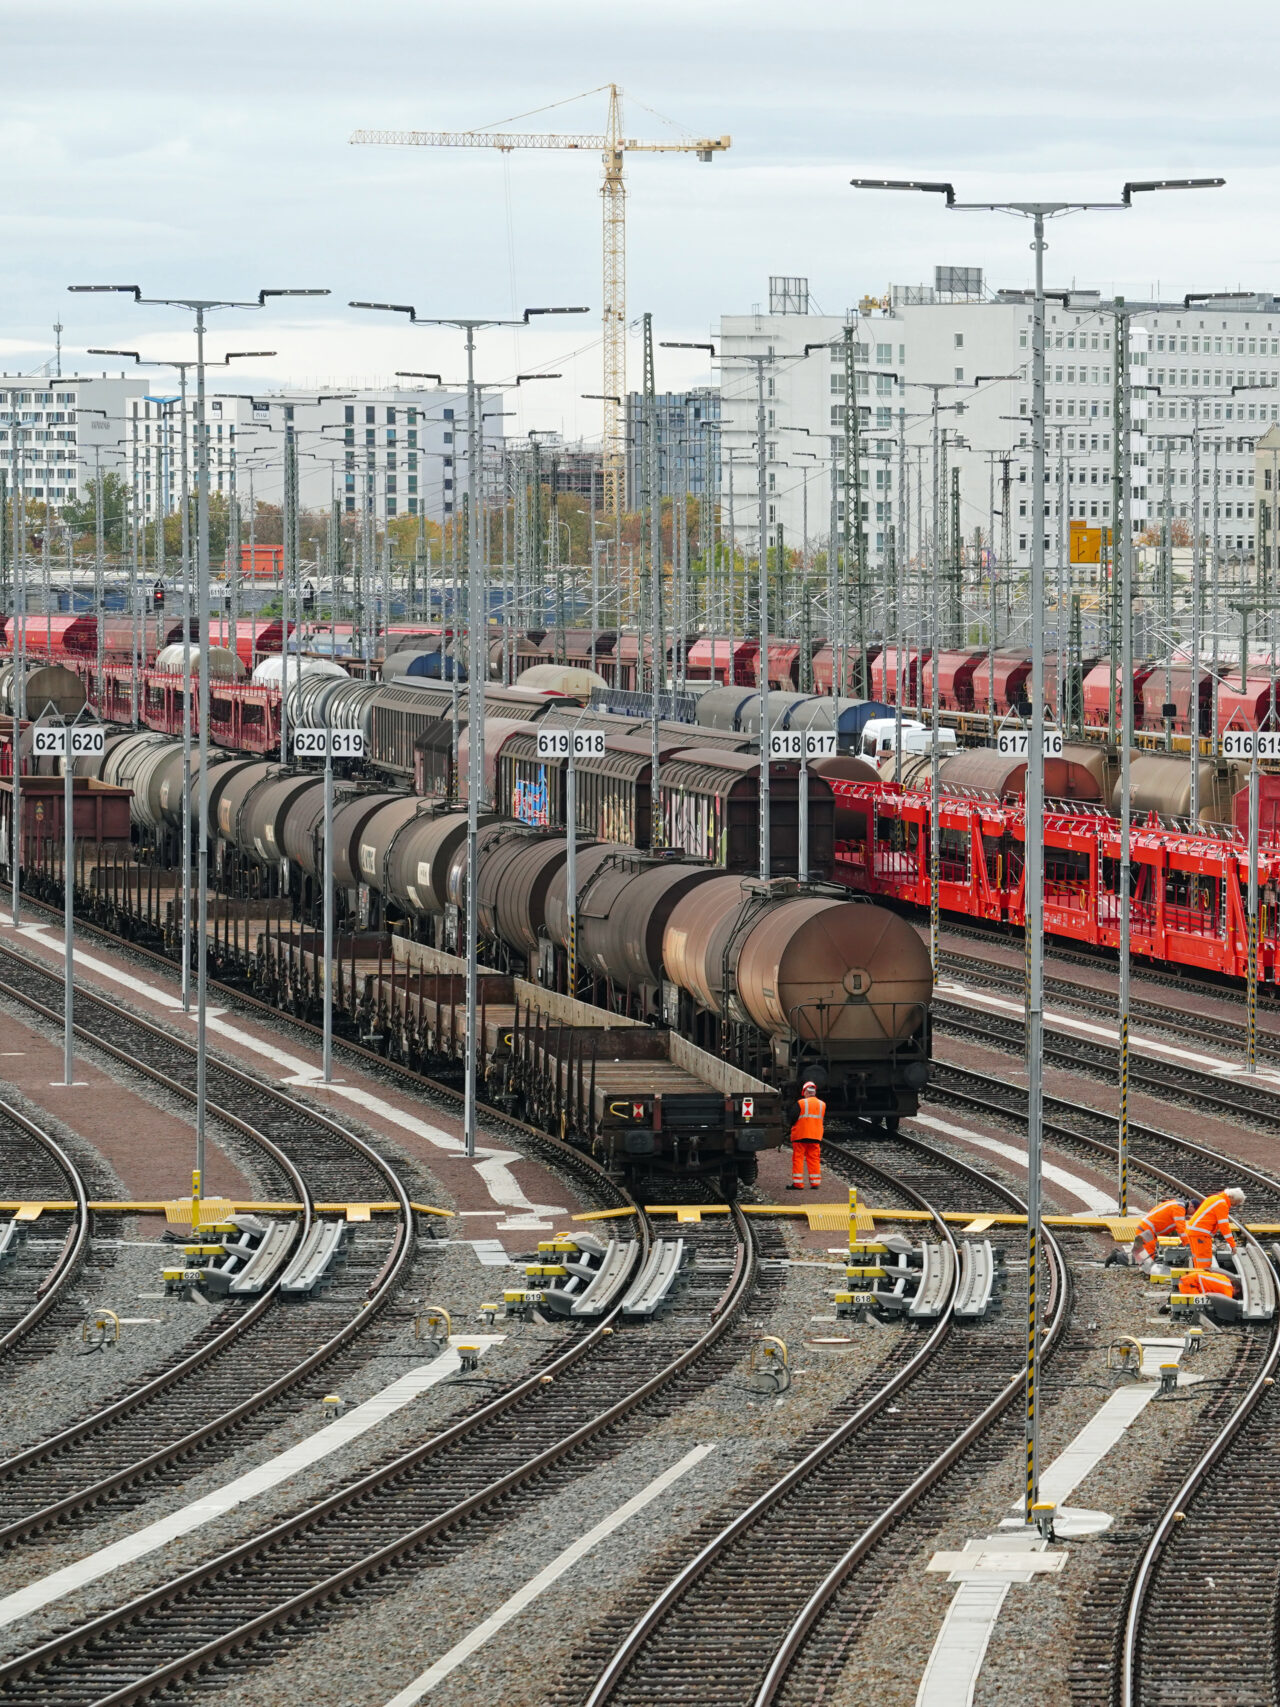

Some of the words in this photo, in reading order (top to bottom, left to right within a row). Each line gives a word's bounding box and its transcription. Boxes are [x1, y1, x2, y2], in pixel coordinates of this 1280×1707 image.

[35, 732, 65, 751] 621
[72, 733, 104, 751] 620
[295, 733, 326, 751] 620
[332, 734, 363, 752] 619
[538, 735, 568, 753] 619
[574, 735, 604, 753] 618
[771, 736, 801, 753] 618
[806, 736, 836, 753] 617
[999, 735, 1028, 753] 617
[1043, 736, 1062, 753] 16
[1224, 736, 1253, 754] 616
[184, 1271, 201, 1279] 620
[525, 1293, 542, 1301] 619
[855, 1295, 872, 1303] 618
